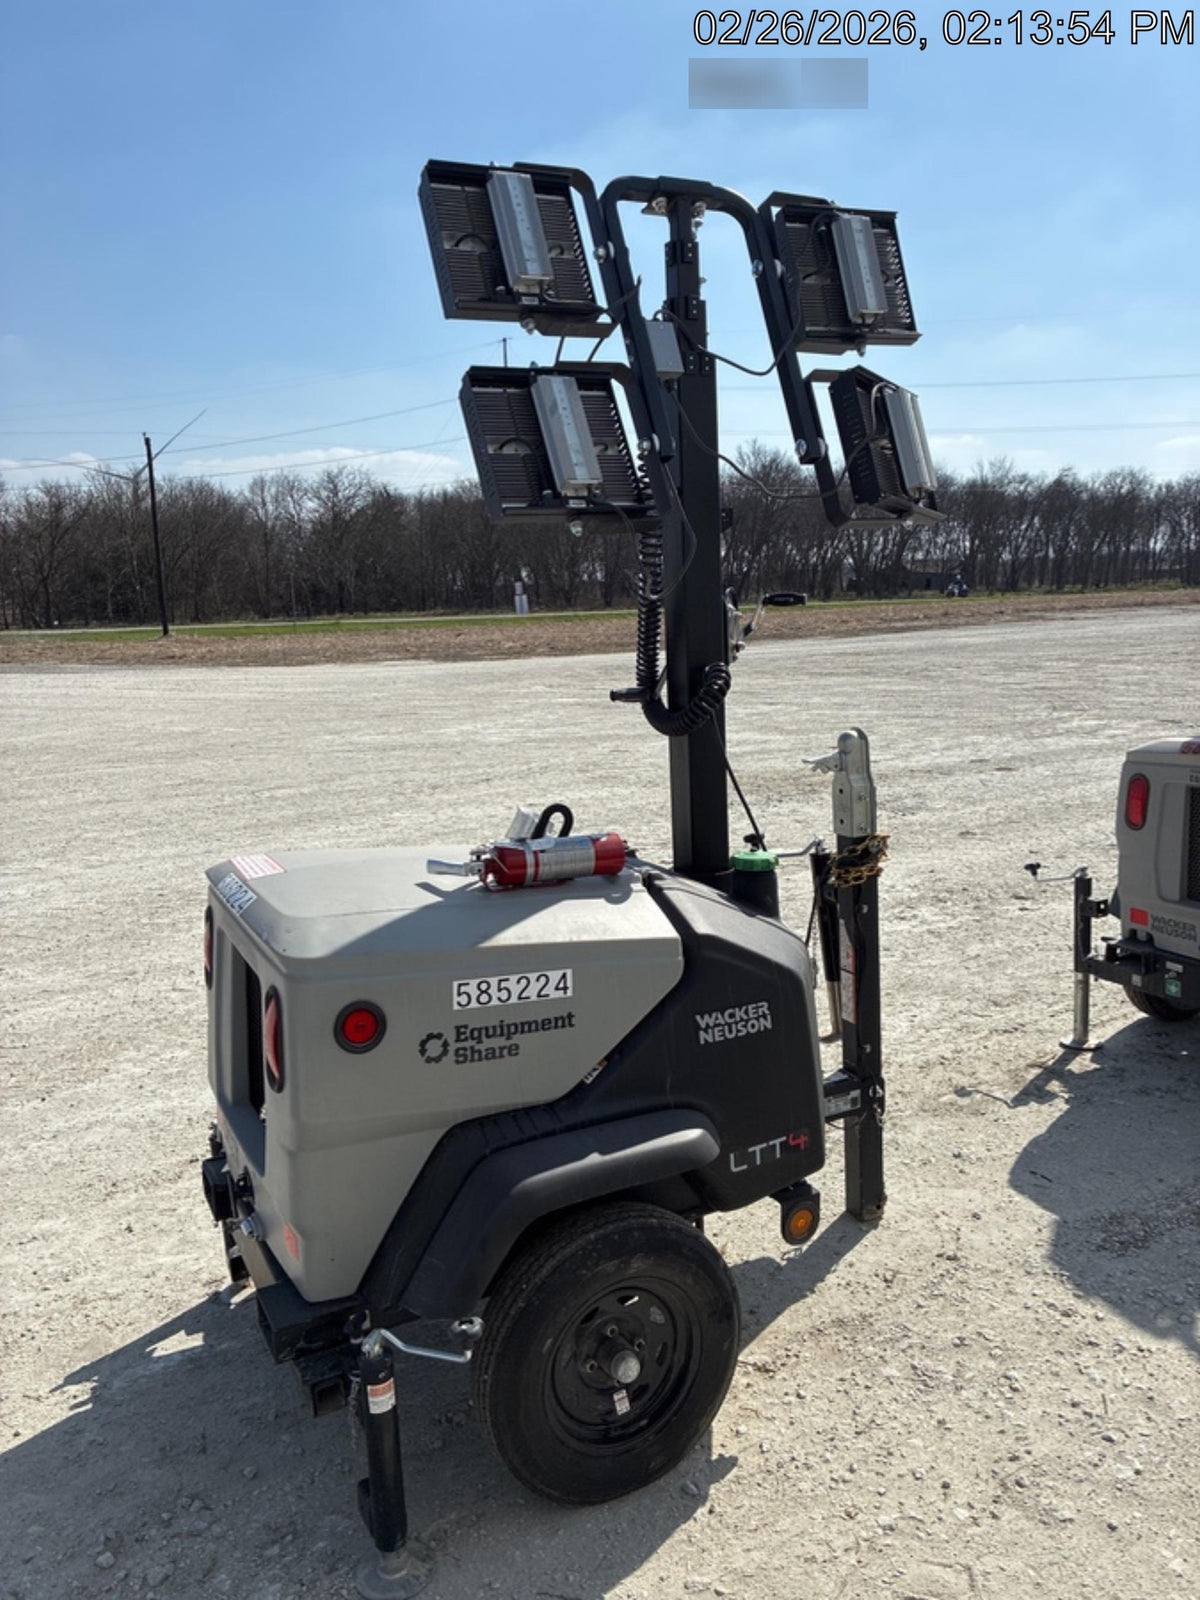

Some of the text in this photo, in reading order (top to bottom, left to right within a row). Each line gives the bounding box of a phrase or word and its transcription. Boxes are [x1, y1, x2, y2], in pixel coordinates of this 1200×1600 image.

[456, 971, 569, 1008] 585224
[454, 1011, 575, 1044] Equipment
[695, 1001, 770, 1029] WACKER
[699, 1014, 773, 1044] NEUSON
[454, 1042, 520, 1065] Share
[730, 1133, 808, 1172] LTT4
